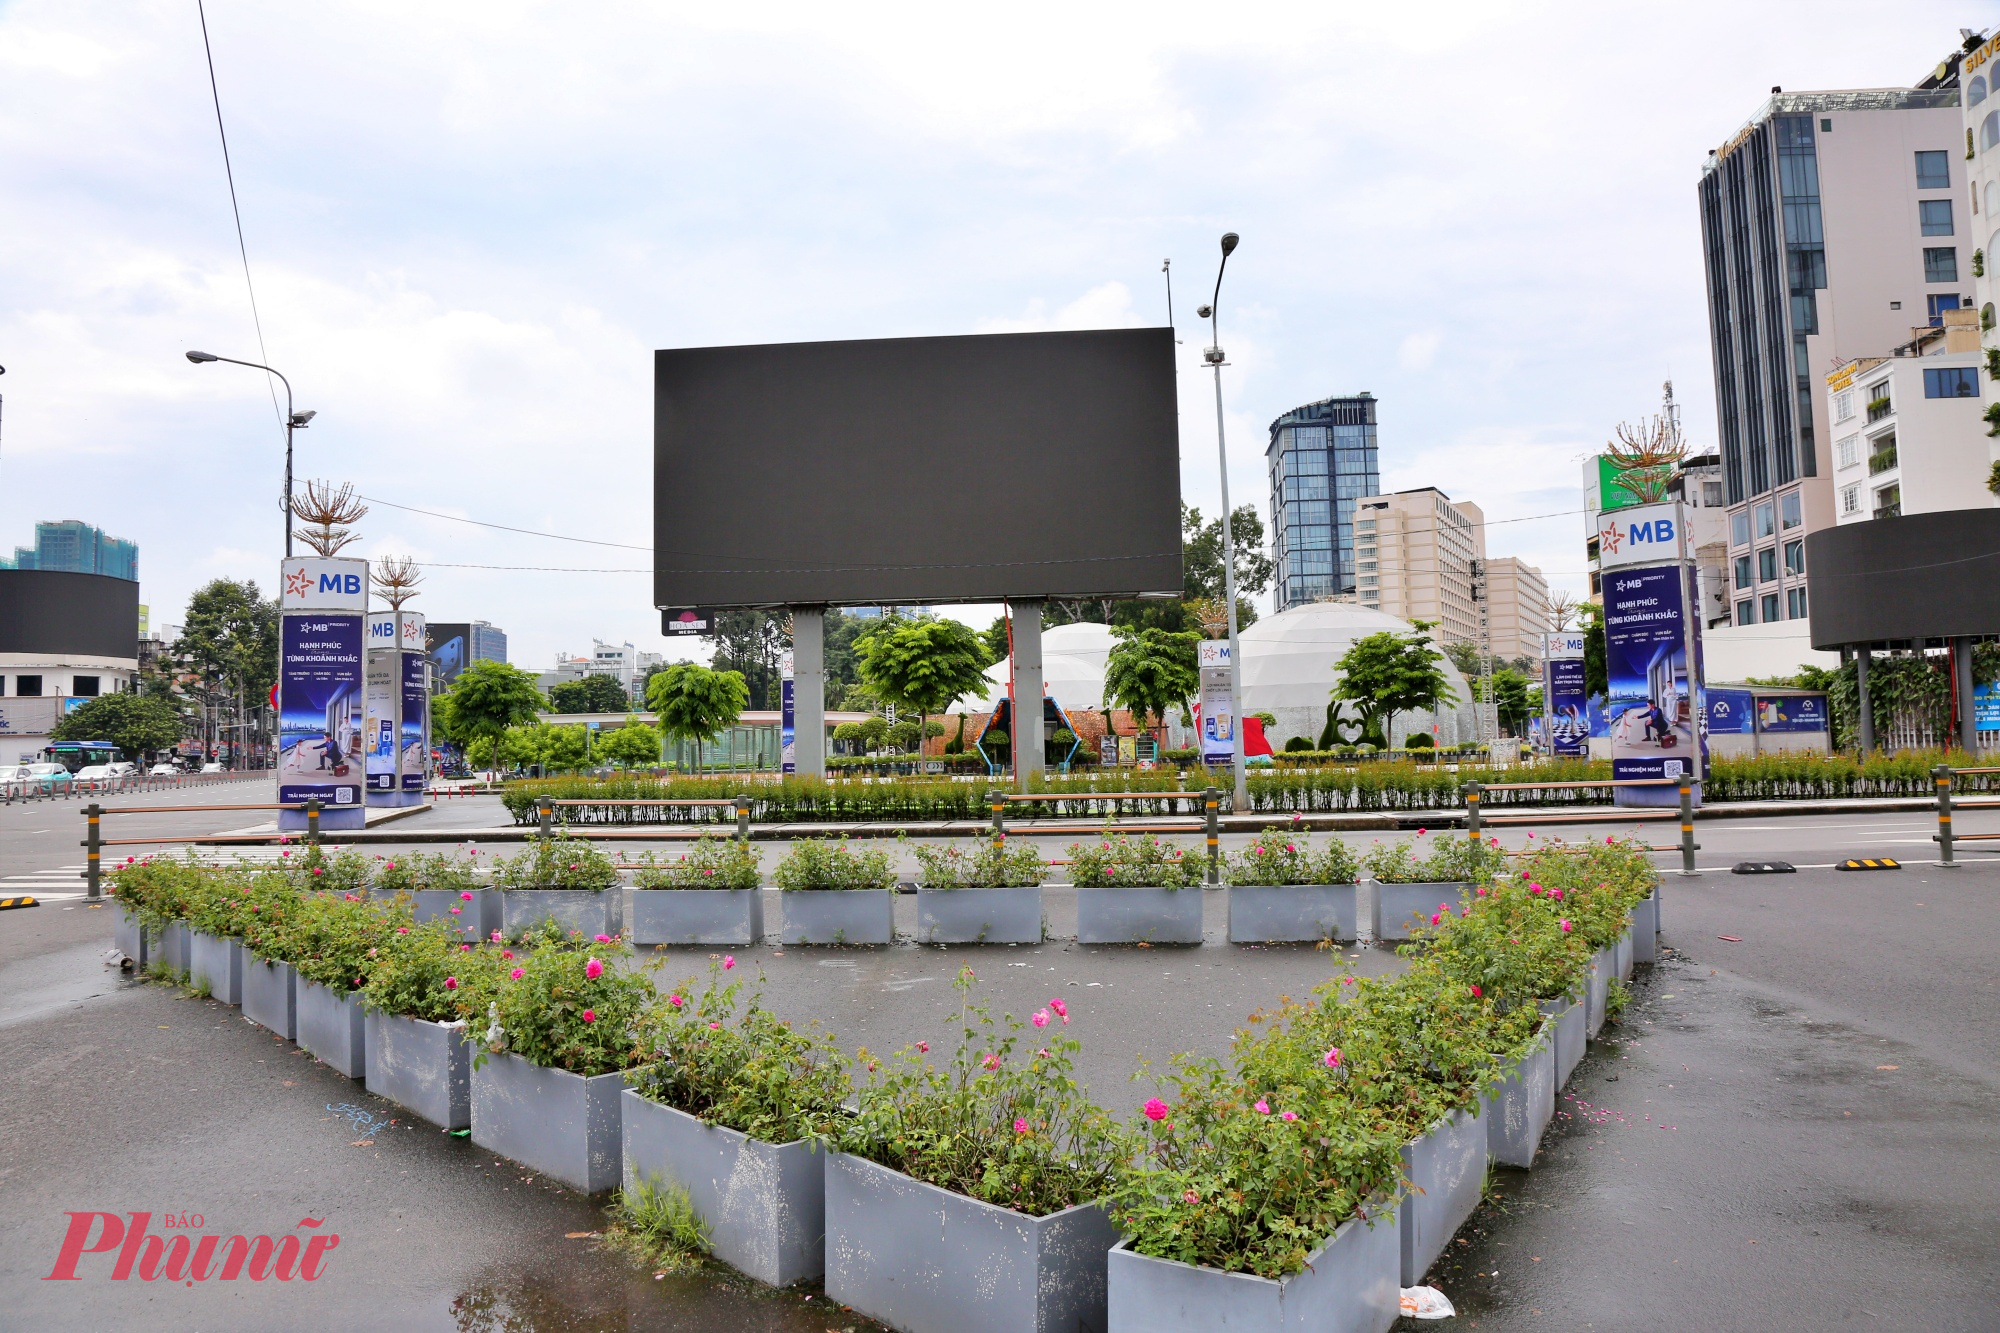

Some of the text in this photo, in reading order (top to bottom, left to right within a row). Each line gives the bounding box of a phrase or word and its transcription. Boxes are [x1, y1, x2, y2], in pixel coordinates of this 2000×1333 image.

[1629, 519, 1675, 546] MB
[319, 573, 361, 594] MB
[1626, 579, 1642, 589] MB
[1616, 597, 1658, 610] HẠNH PHÚC
[312, 624, 328, 632] MB
[372, 622, 394, 637] MB
[299, 641, 342, 650] HẠNH PHÚC
[1567, 640, 1582, 649] MB
